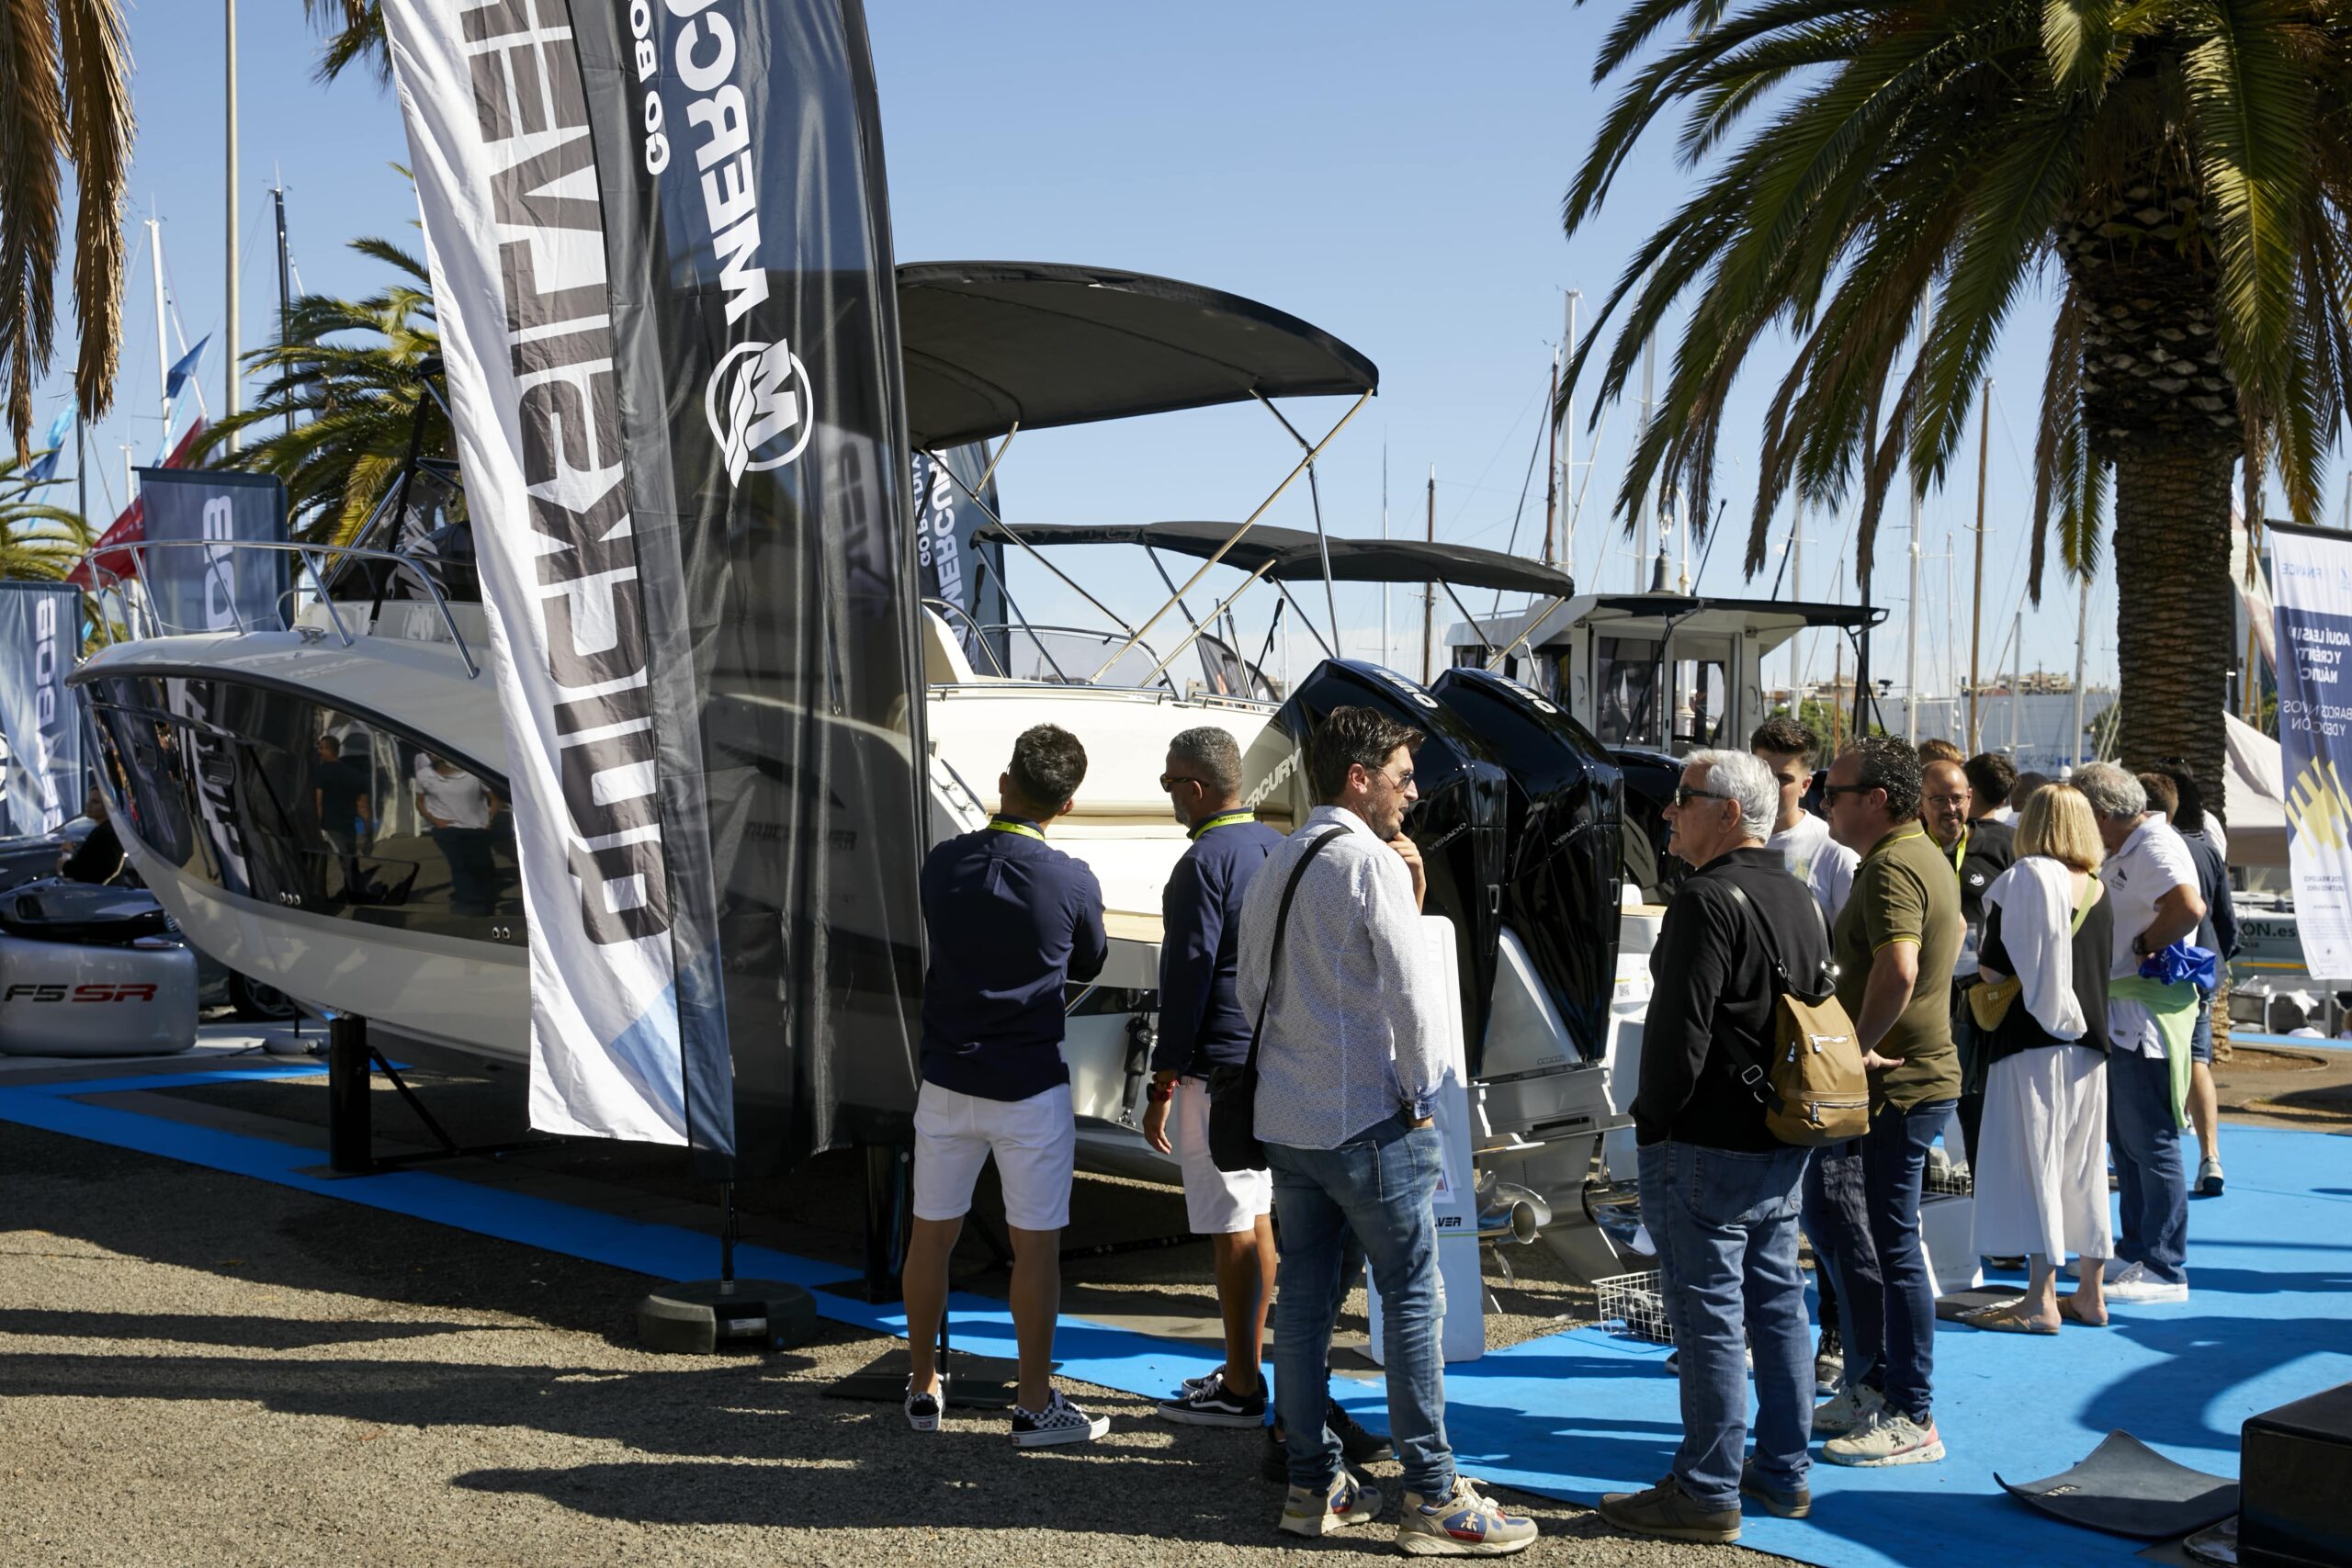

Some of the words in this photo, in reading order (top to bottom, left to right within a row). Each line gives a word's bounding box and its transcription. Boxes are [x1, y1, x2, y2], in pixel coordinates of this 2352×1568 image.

[1428, 822, 1467, 852] VERADO
[1551, 818, 1589, 847] VERADO
[2240, 921, 2297, 938] ON.es
[4, 984, 69, 1003] F5
[72, 984, 159, 1003] SR
[1434, 1216, 1463, 1228] VER
